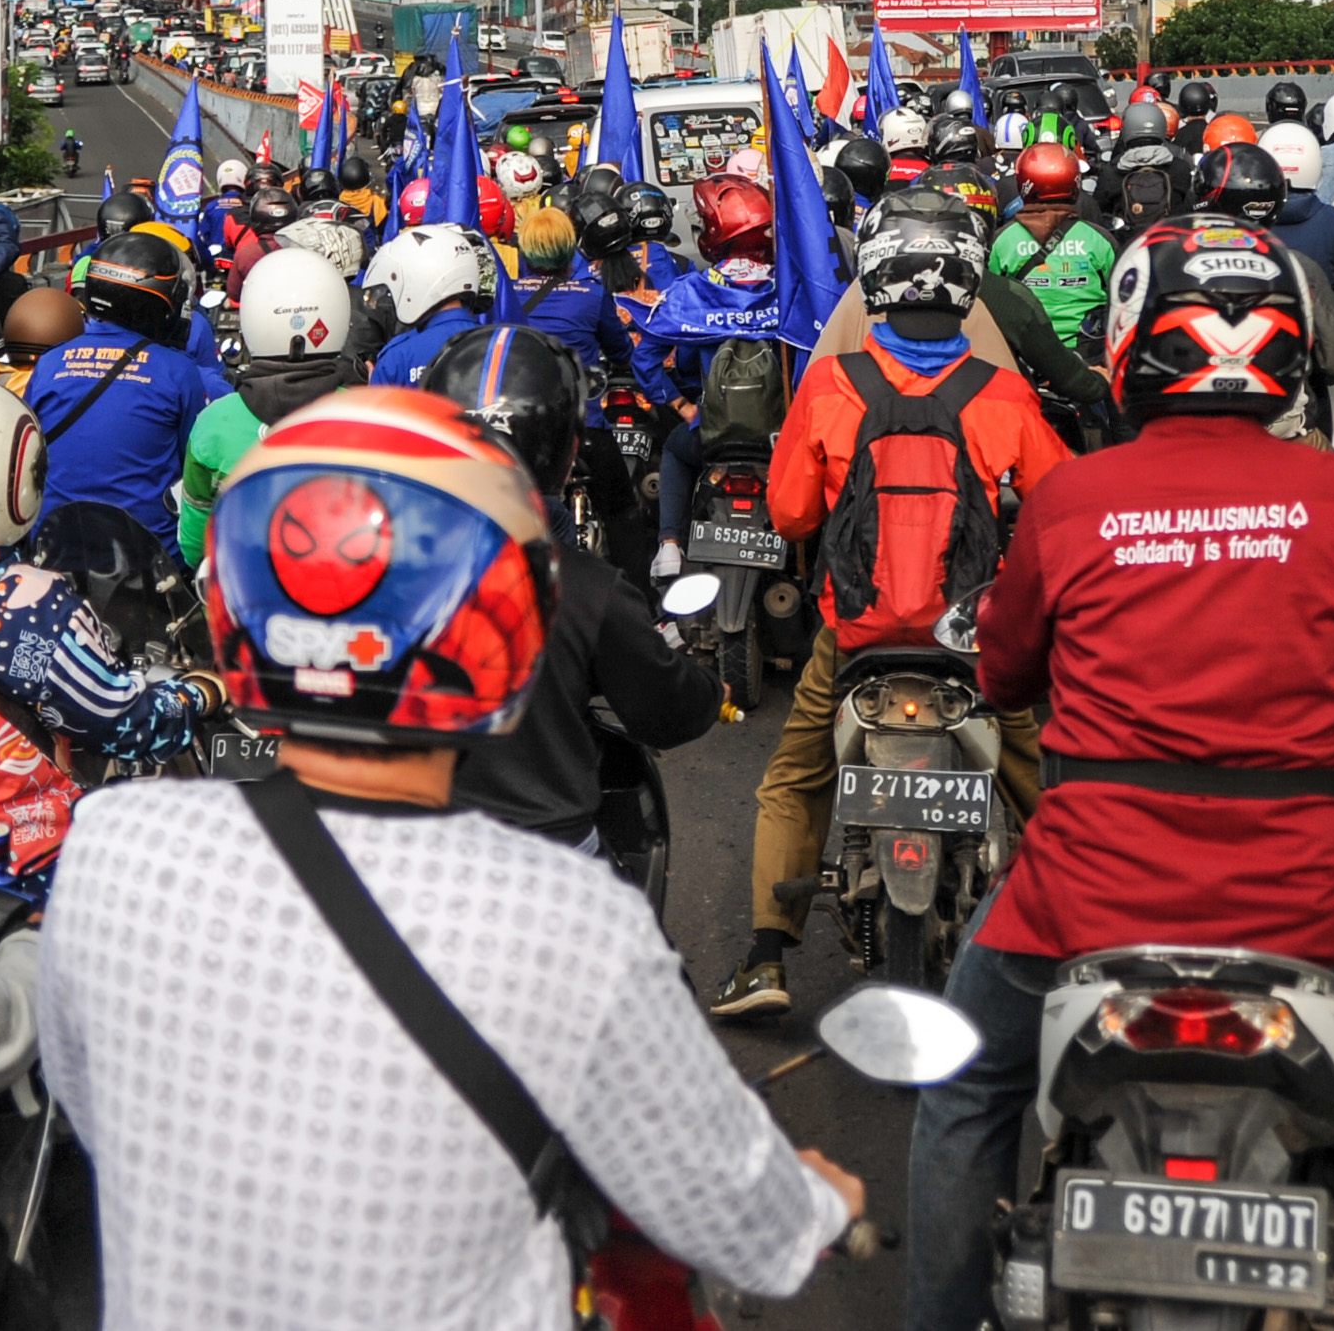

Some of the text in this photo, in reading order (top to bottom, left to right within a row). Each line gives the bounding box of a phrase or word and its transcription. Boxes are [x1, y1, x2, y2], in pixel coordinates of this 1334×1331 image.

[1201, 257, 1268, 274] SHOEI
[706, 311, 724, 327] PC
[726, 310, 754, 325] FSP
[75, 347, 95, 359] FSP
[1215, 379, 1245, 390] DOT
[696, 524, 704, 540] D
[714, 526, 749, 545] 6538
[1114, 533, 1292, 568] solidarity is friority
[216, 738, 227, 758] D
[843, 772, 857, 795] D
[954, 777, 987, 802] XA
[1071, 1188, 1312, 1249] D 6977 VDT
